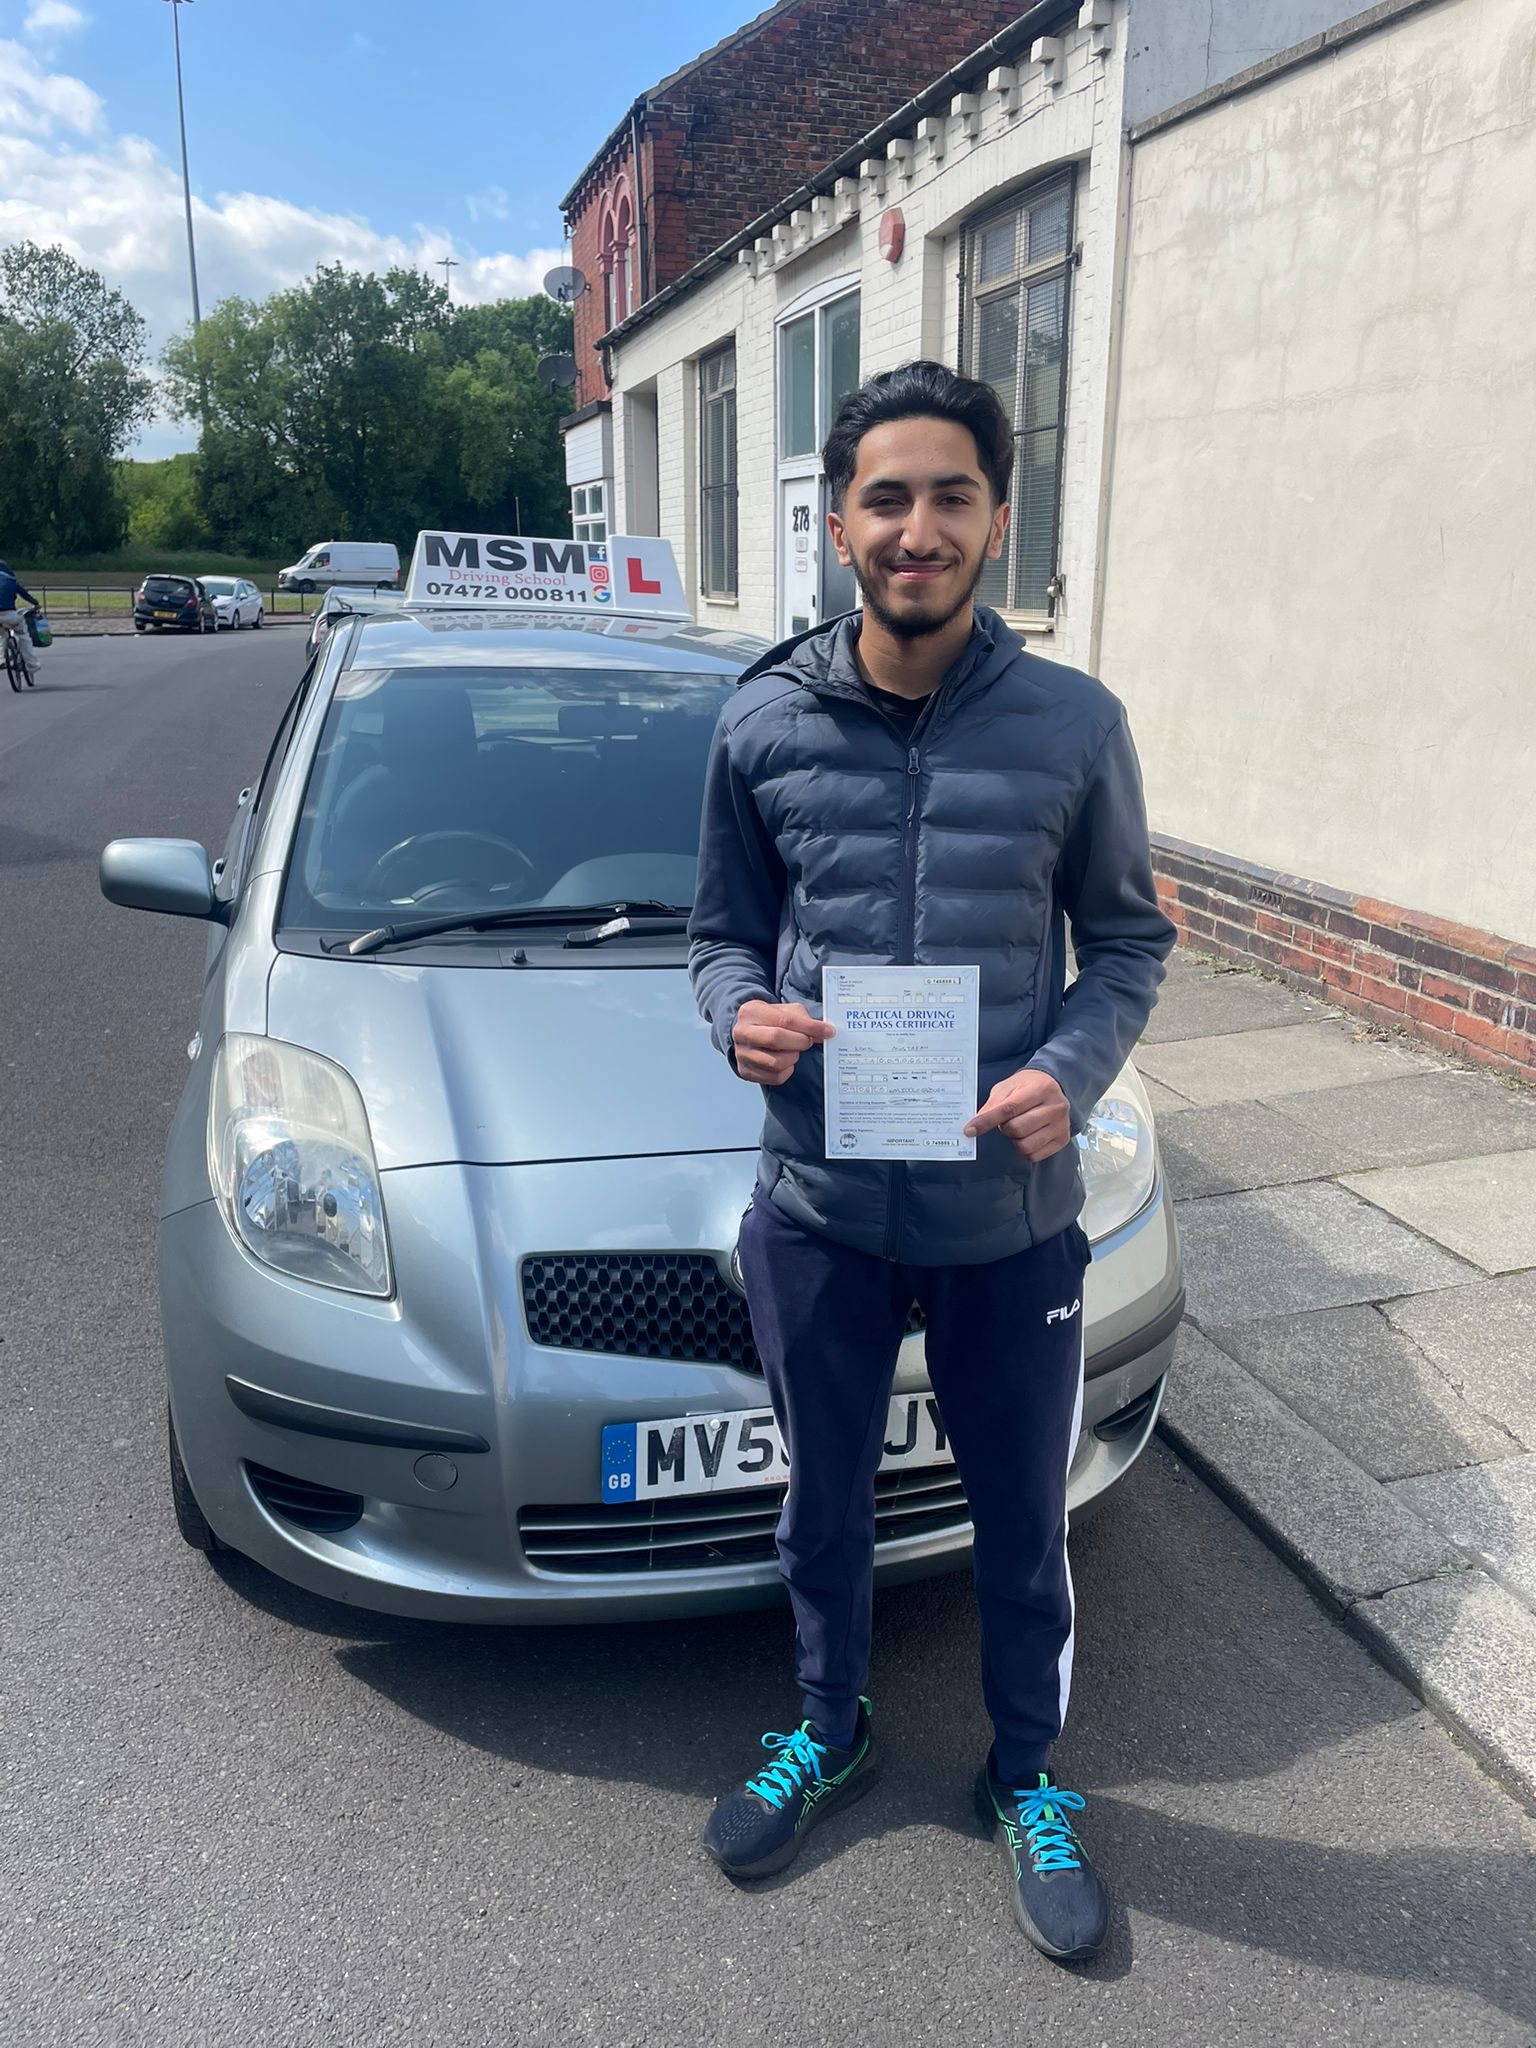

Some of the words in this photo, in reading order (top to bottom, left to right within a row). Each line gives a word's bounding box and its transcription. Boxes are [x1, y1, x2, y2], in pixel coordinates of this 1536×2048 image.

[792, 505, 810, 532] 278
[424, 535, 586, 574] MSM
[448, 568, 511, 586] Driving
[514, 573, 568, 586] School
[626, 557, 661, 595] L
[426, 582, 499, 599] 07472
[504, 586, 588, 602] 000811
[846, 1010, 903, 1019] PRACTICAL
[906, 1010, 955, 1019] DRIVING
[847, 1020, 867, 1029] TEST
[870, 1020, 893, 1029] PASS
[895, 1020, 955, 1029] CERTIFICATE
[1046, 1298, 1080, 1325] FILA
[647, 1415, 790, 1486] MV5
[607, 1471, 631, 1490] GB
